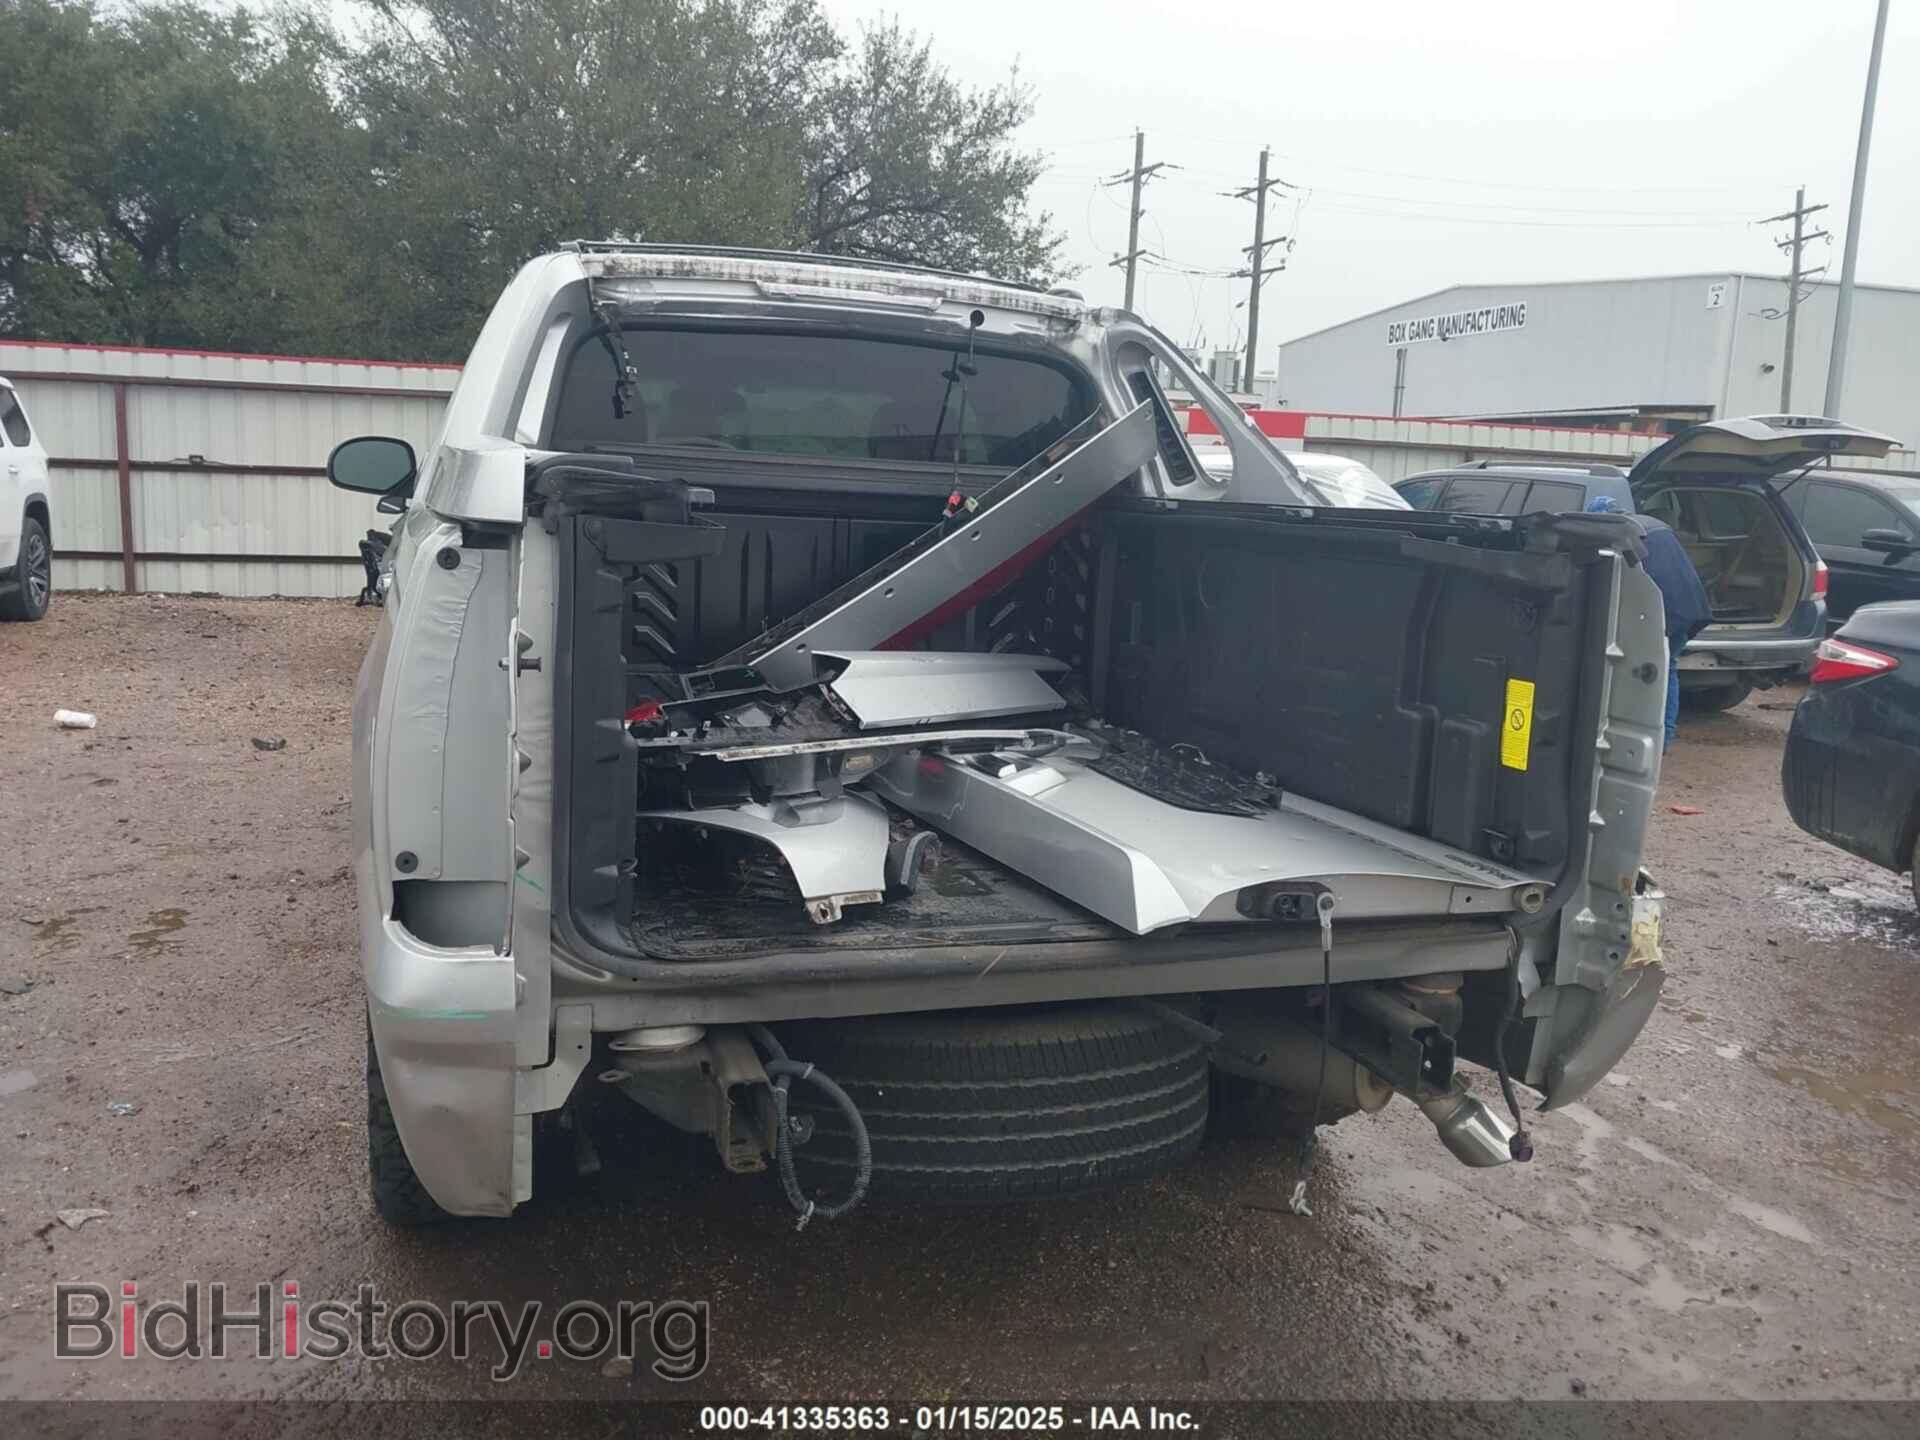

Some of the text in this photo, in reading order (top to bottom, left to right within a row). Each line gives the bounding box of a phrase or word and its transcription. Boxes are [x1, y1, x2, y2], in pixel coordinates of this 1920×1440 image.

[1713, 293, 1720, 305] 2
[1388, 303, 1526, 343] BOX GANG MANUFACTURING
